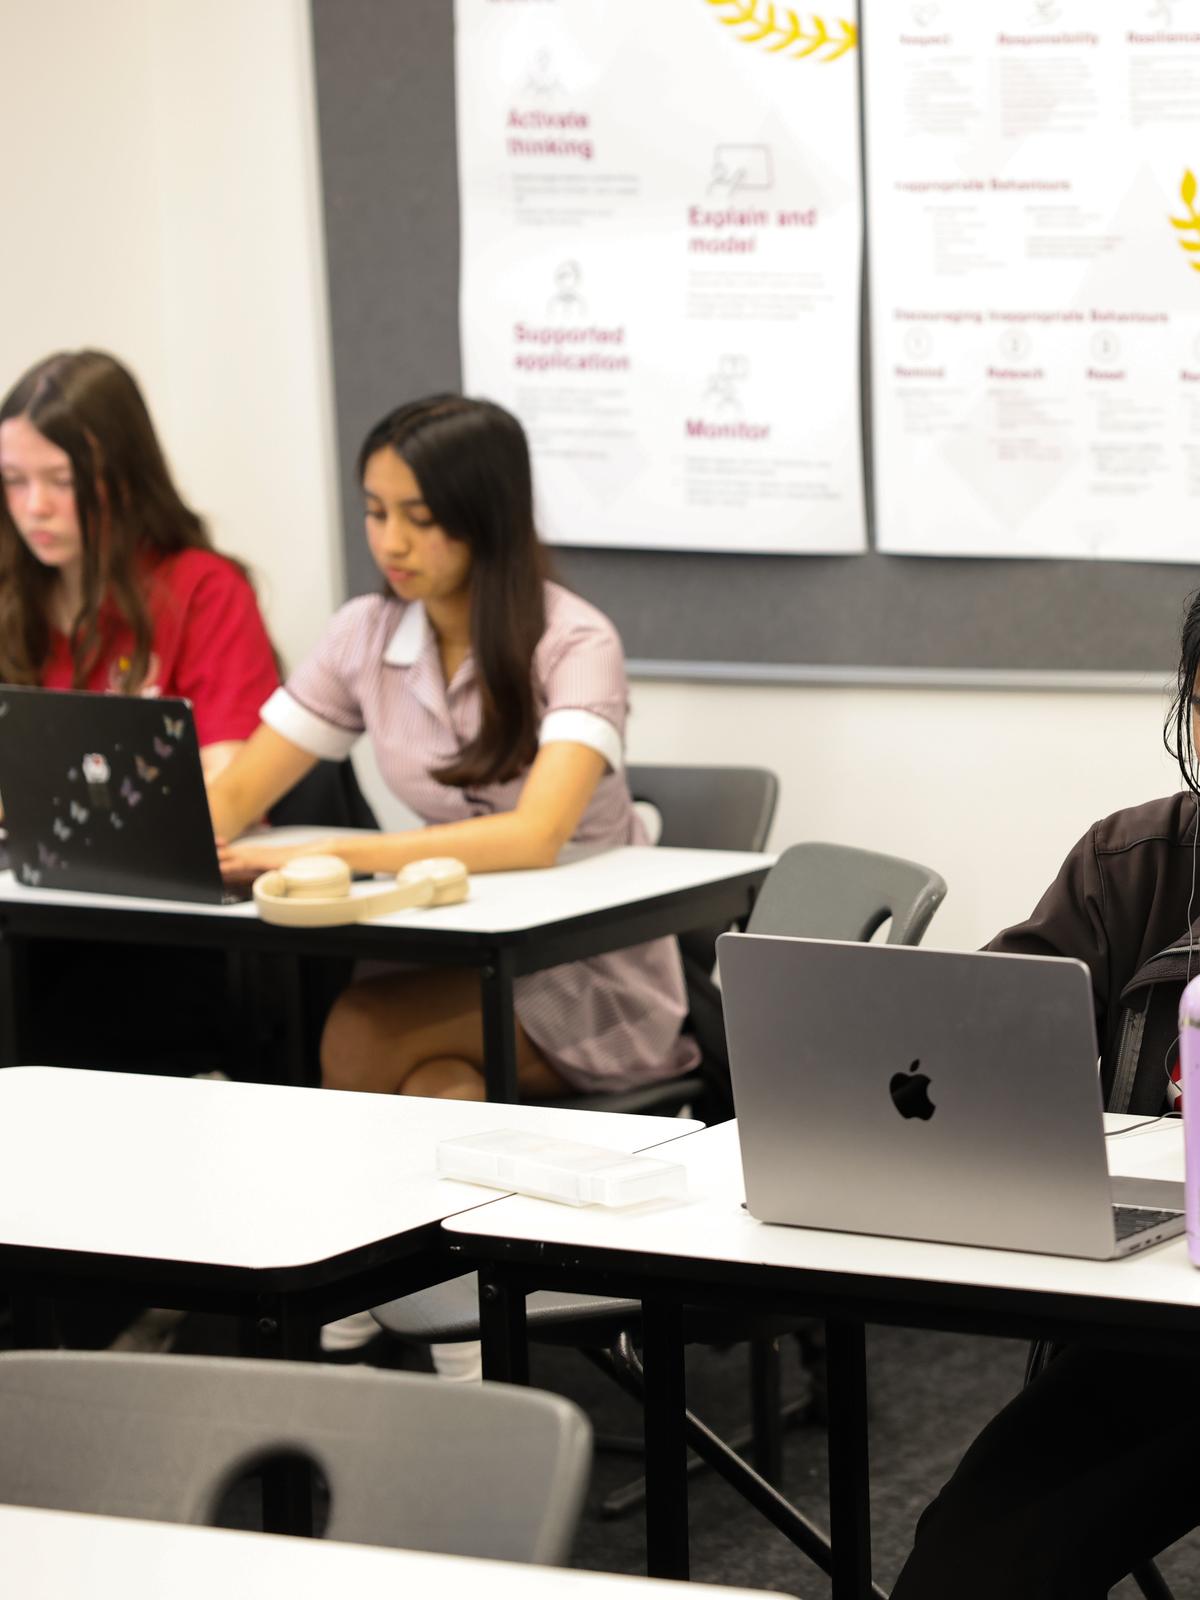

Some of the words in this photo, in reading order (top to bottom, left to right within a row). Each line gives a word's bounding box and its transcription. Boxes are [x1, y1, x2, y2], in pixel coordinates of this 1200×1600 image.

[507, 107, 590, 129] Activate
[506, 136, 595, 160] thinking
[688, 206, 769, 230] Explain
[776, 208, 817, 227] and
[688, 233, 757, 254] model
[514, 323, 626, 347] Supported
[515, 352, 632, 374] application
[685, 418, 771, 441] Monitor
